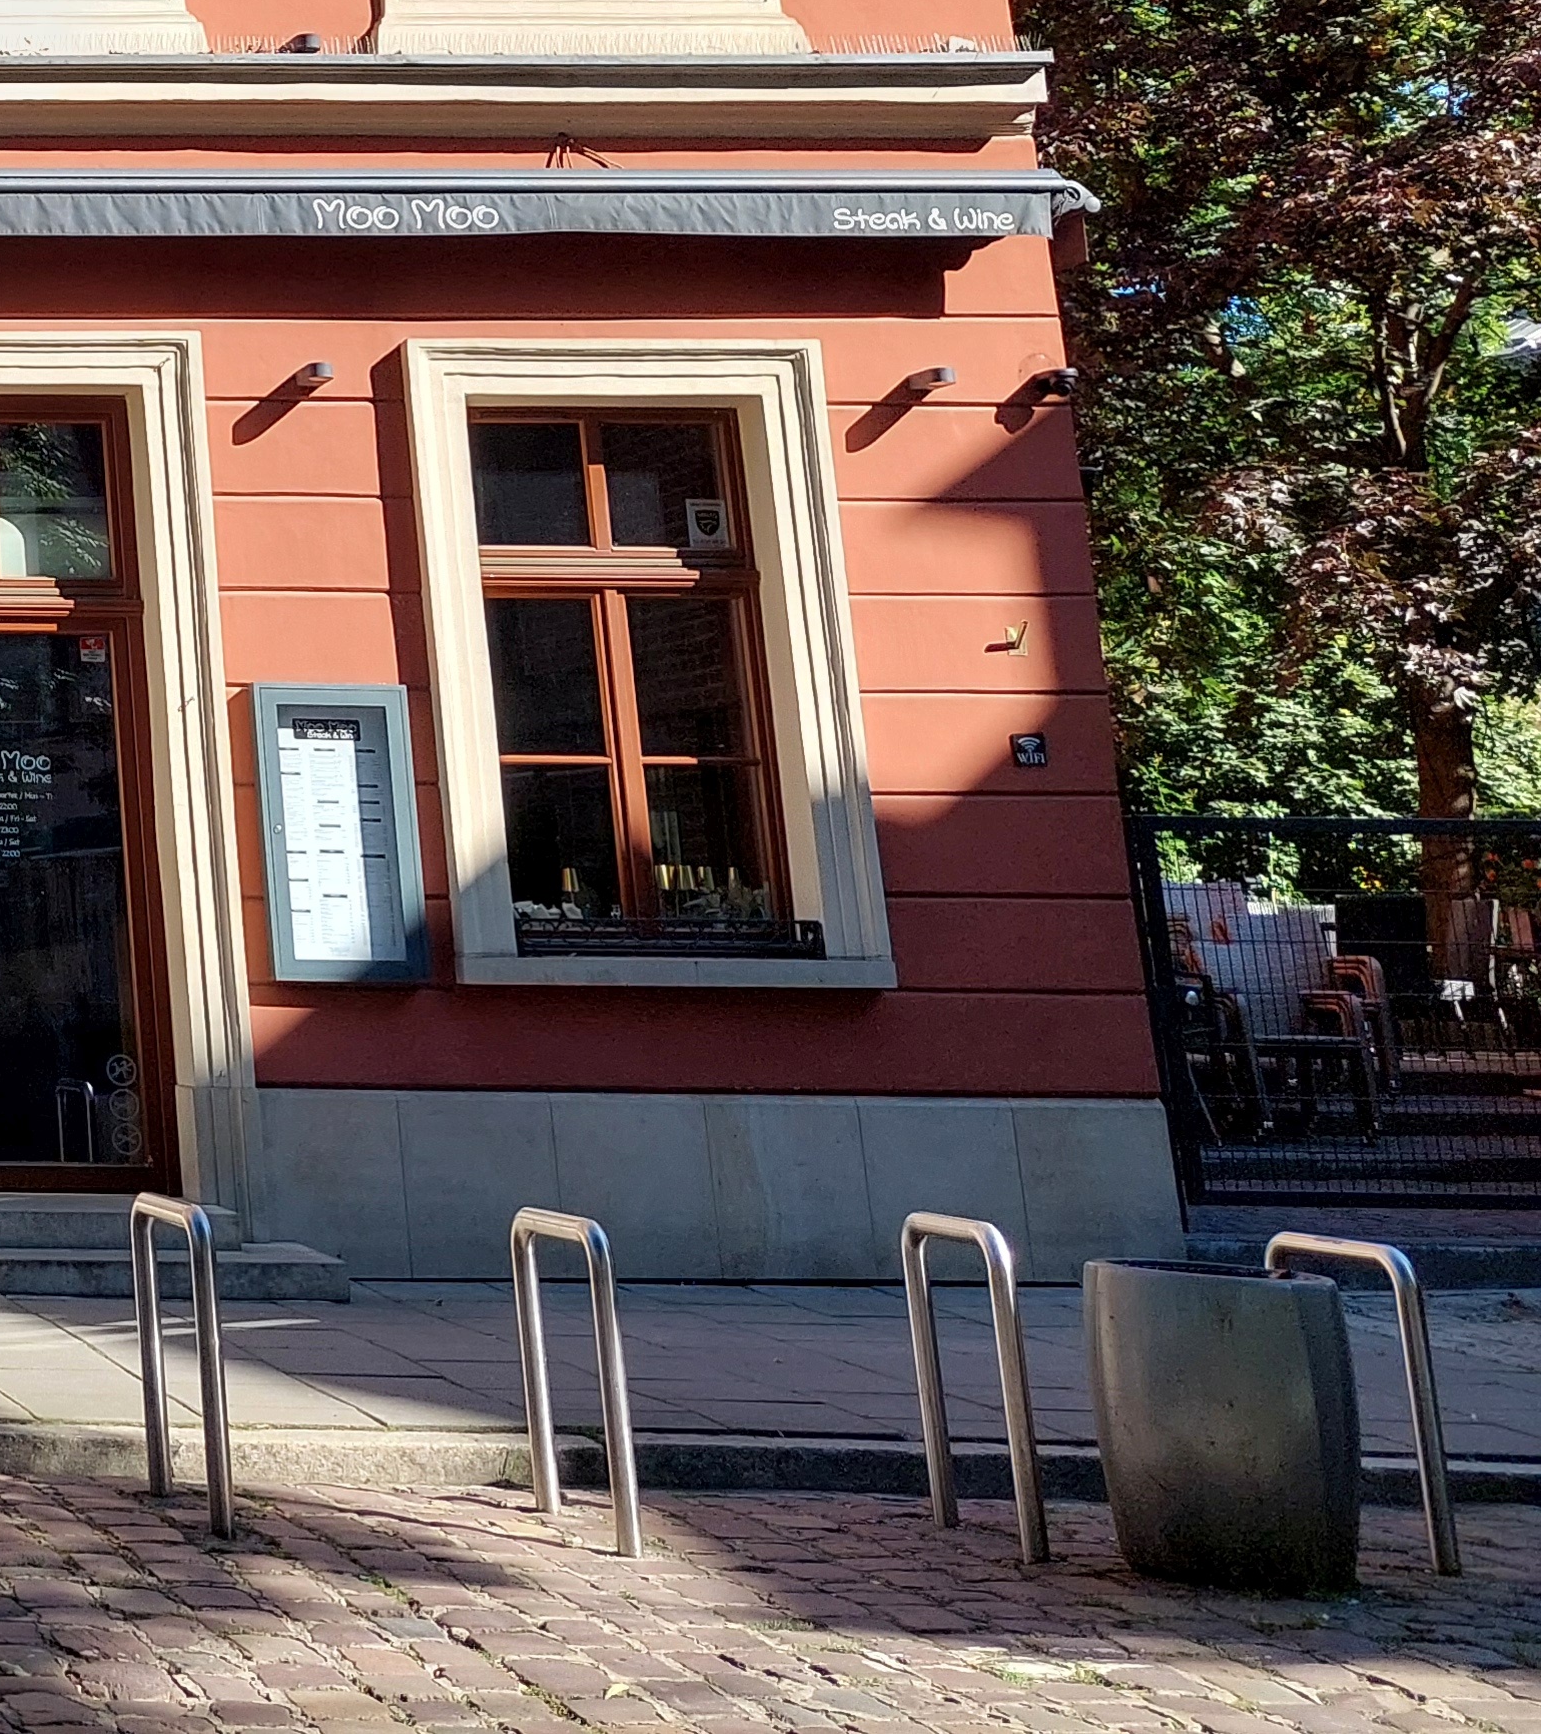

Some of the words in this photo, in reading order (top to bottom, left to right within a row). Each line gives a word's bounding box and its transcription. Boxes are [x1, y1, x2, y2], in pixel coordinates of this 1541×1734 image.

[312, 198, 399, 229] Moo
[411, 198, 499, 229] Moo
[833, 207, 921, 230] Steak
[927, 207, 948, 230] &
[953, 207, 1015, 230] Wine
[1, 750, 51, 771] Moo
[7, 770, 18, 783] &
[22, 771, 52, 784] Wine
